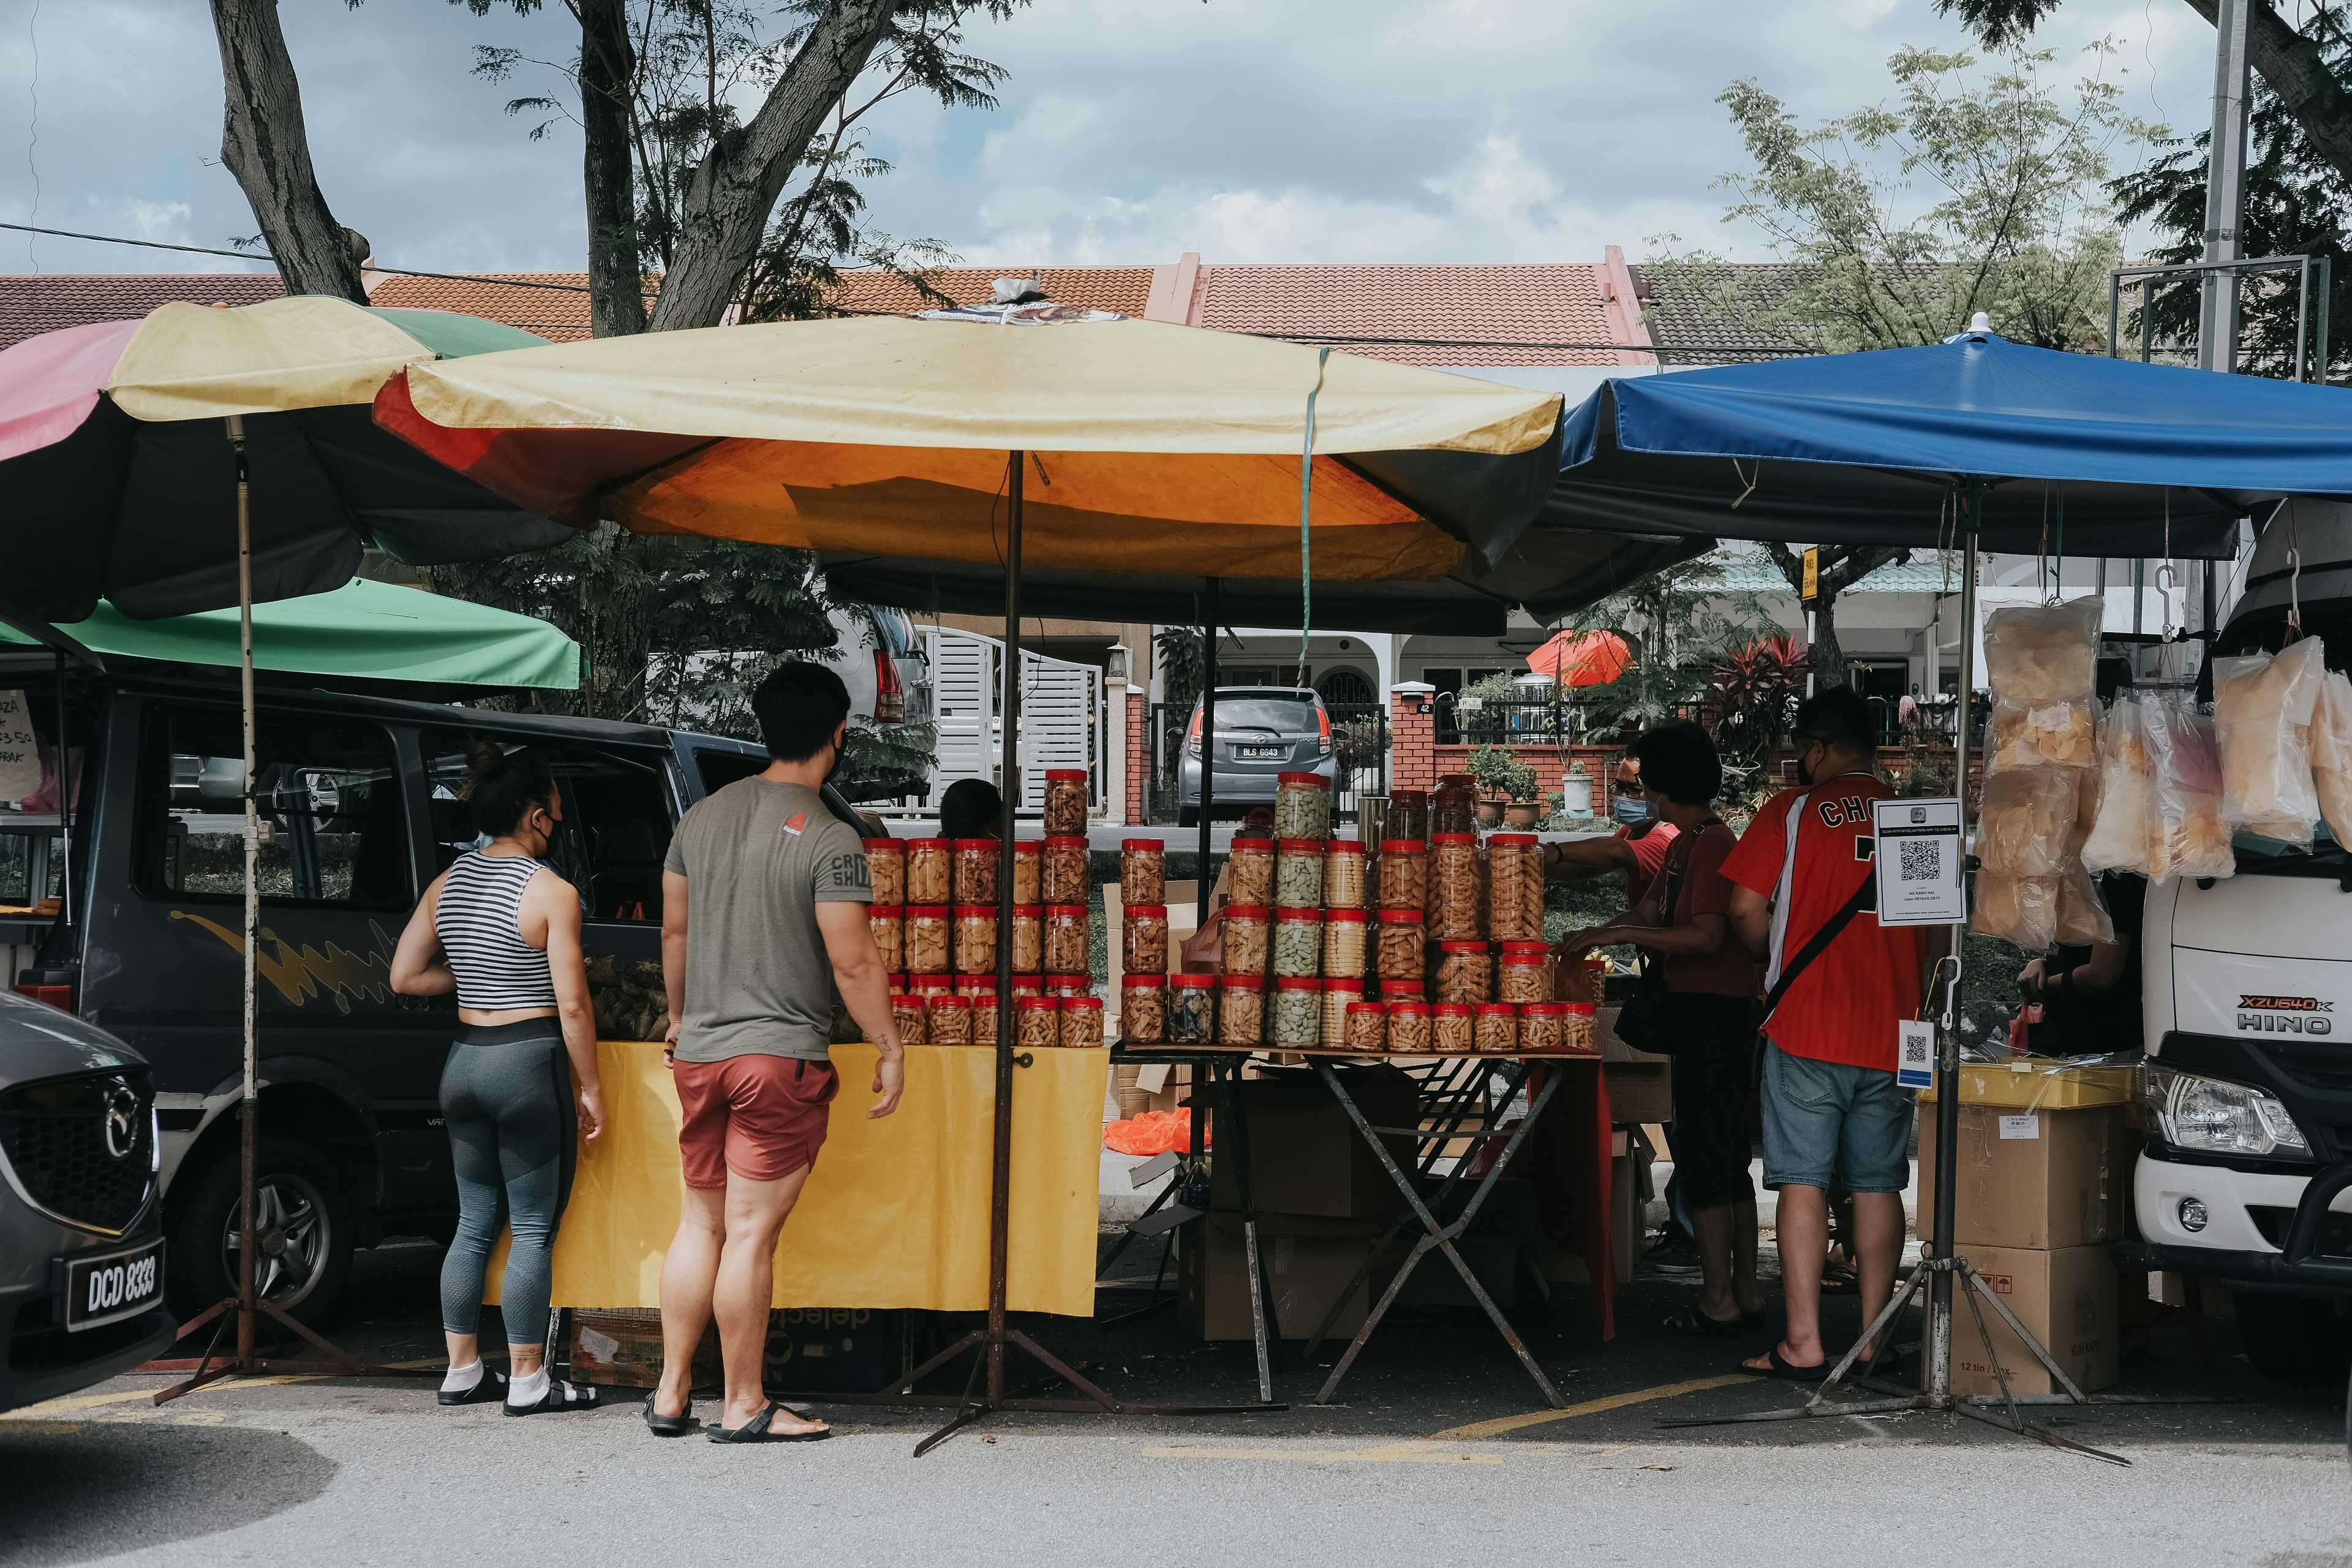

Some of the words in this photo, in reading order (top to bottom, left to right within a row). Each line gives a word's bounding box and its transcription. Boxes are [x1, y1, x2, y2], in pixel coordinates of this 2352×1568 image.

[1243, 748, 1256, 756] BLS
[1259, 748, 1278, 756] 6643
[2237, 1014, 2331, 1035] HINO
[88, 1266, 124, 1312] DCD
[125, 1256, 156, 1302] 8333
[1961, 1362, 1971, 1371] 12
[1973, 1363, 1985, 1373] tin
